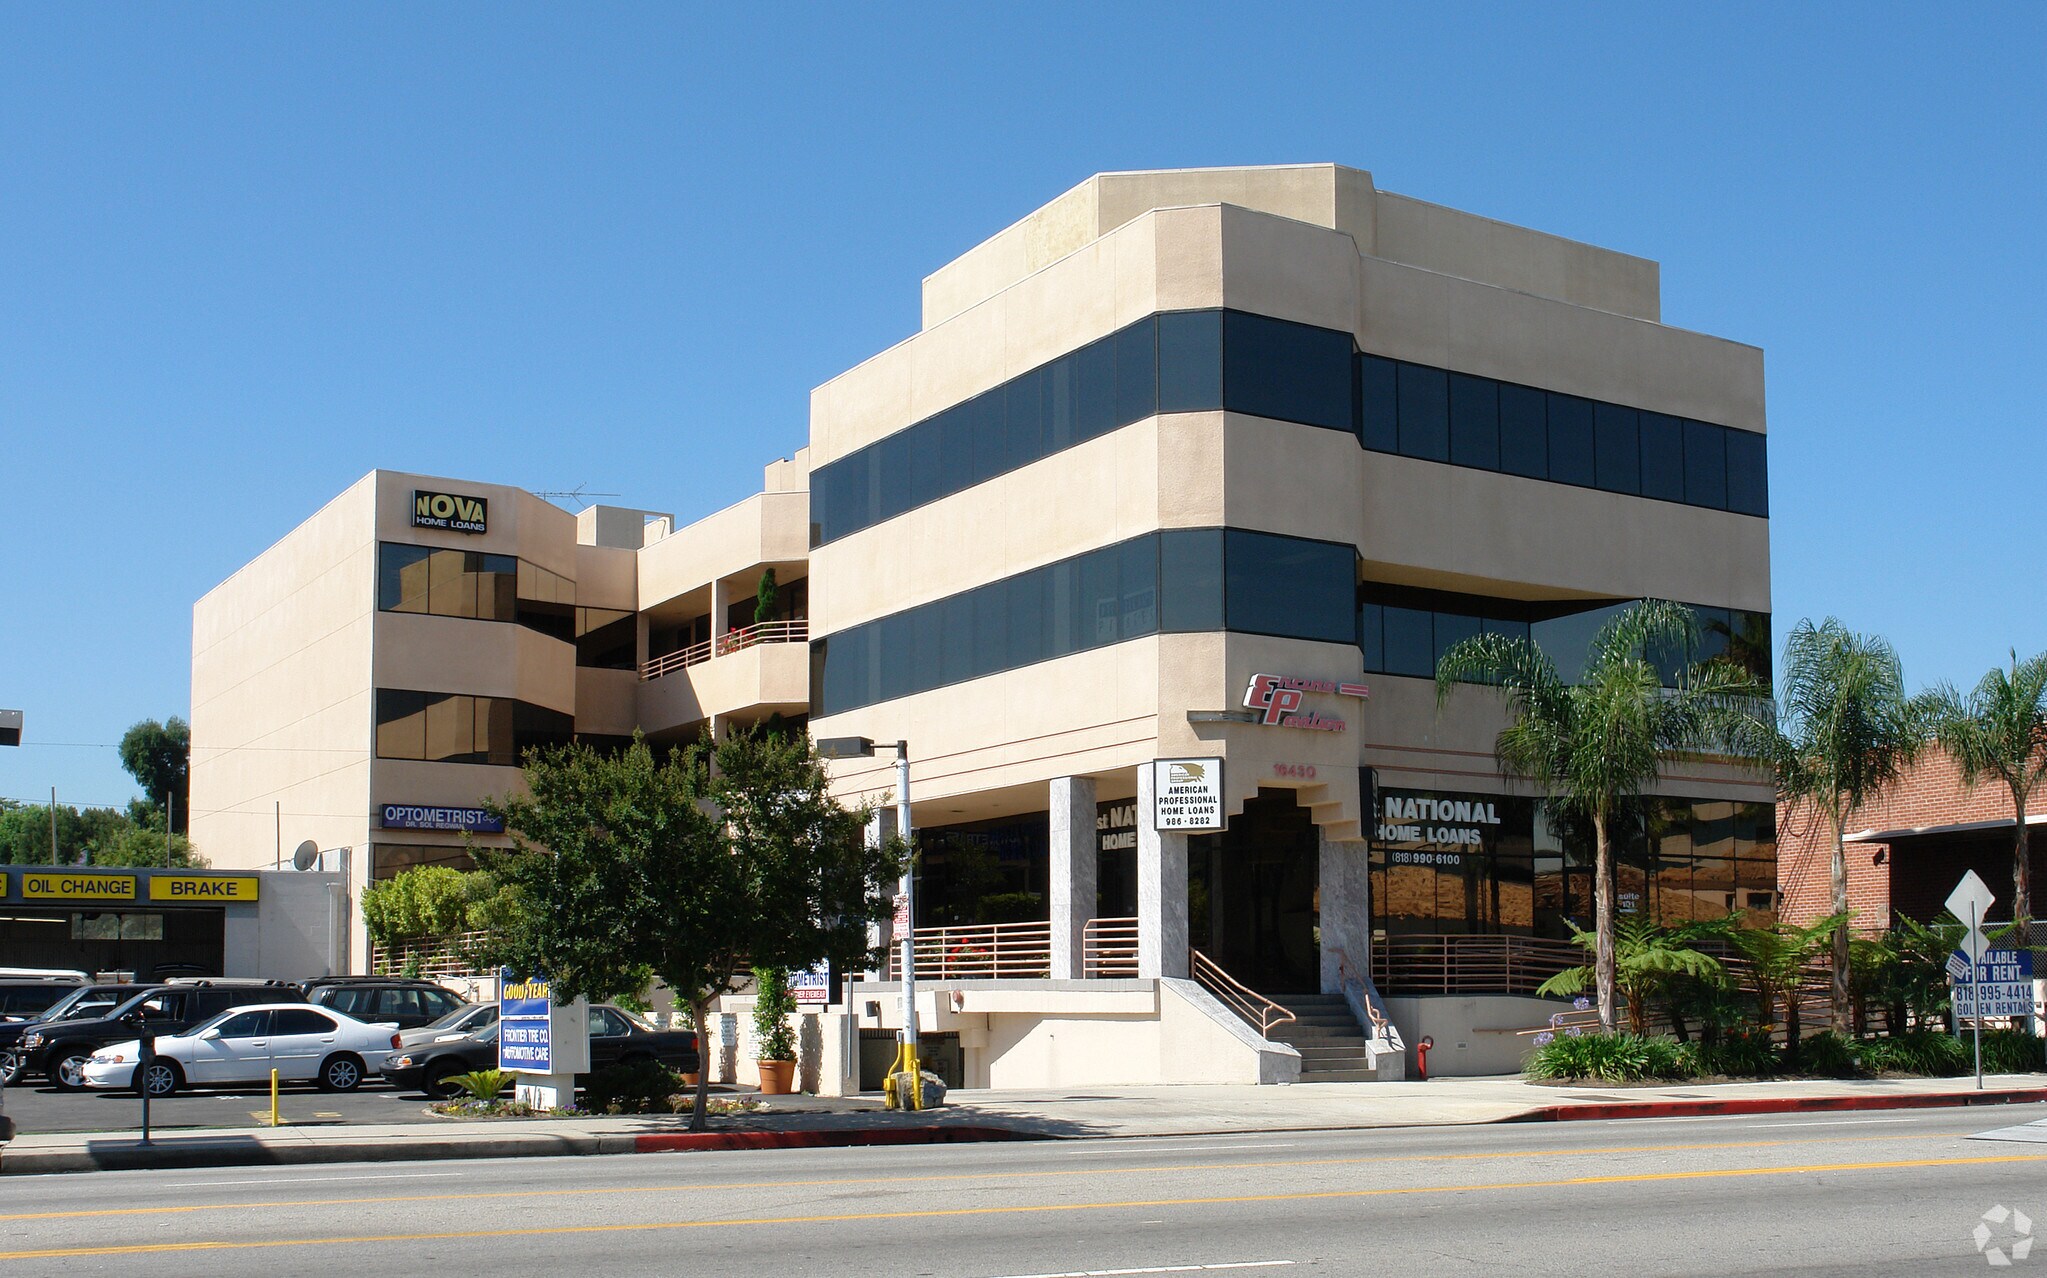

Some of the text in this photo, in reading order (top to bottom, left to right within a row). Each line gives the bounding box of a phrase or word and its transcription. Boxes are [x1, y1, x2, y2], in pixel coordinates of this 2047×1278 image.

[416, 494, 485, 523] NOVA
[416, 516, 485, 531] HOME LOANS
[1168, 786, 1209, 794] AMERICAN
[1158, 796, 1218, 805] PROFESSIONAL
[385, 806, 484, 824] OPTOMETRIST
[1161, 806, 1215, 815] HOME LOANS
[1385, 796, 1500, 824] NATIONAL
[405, 820, 417, 828] DR.
[419, 821, 434, 829] SOL
[1102, 831, 1137, 850] HOME
[1426, 826, 1481, 844] LOANS
[1413, 853, 1460, 865] 990-6100
[28, 879, 131, 894] OIL CHANGE
[171, 881, 238, 896] BRAKE
[1992, 965, 2021, 981] RENT
[503, 980, 548, 1000] GOODYEAR
[1957, 1001, 2034, 1015] GOLEN RENTALS
[528, 1030, 539, 1043] TIRE
[540, 1029, 549, 1044] CO.
[534, 1047, 549, 1061] CARE
